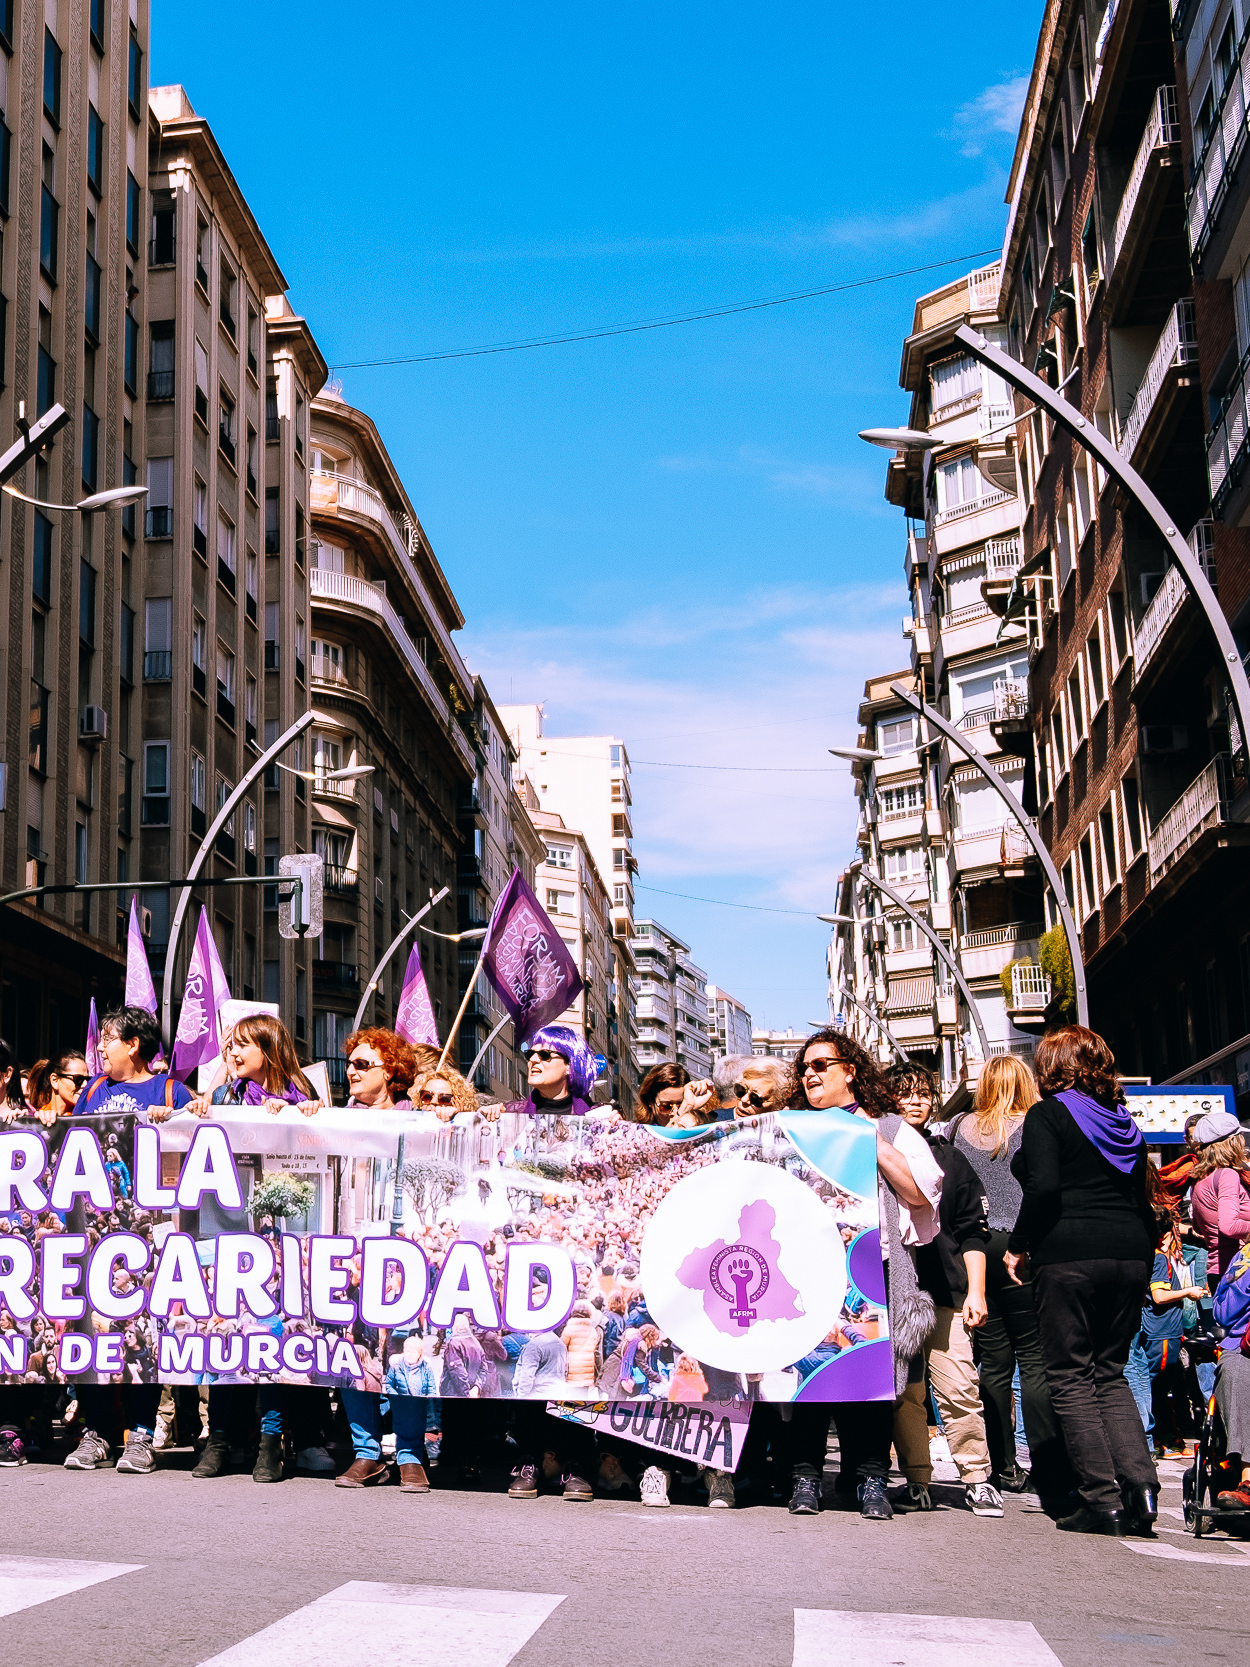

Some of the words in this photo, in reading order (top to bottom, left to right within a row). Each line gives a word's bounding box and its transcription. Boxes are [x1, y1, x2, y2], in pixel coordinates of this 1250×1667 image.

[518, 907, 565, 986] FORUM
[132, 1122, 244, 1211] LA
[752, 1275, 768, 1300] MURCIA
[58, 1332, 124, 1374] DE
[158, 1332, 364, 1380] MURCIA
[610, 1400, 733, 1468] GUERRERA
